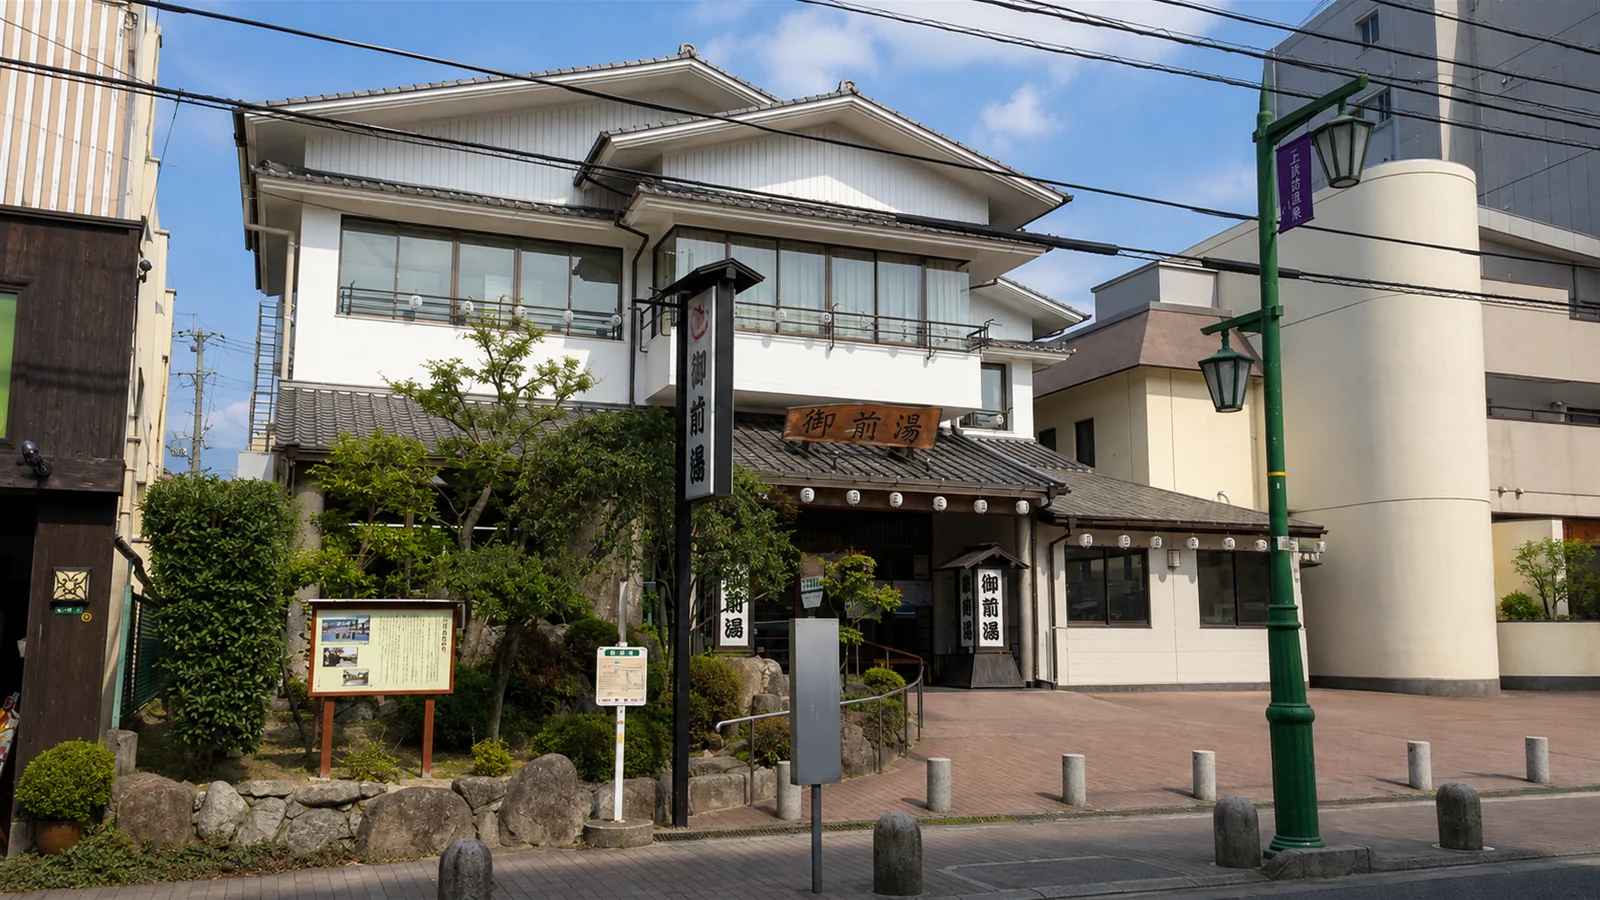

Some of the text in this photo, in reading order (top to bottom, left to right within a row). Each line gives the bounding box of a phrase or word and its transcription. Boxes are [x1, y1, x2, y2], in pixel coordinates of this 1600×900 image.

[1290, 148, 1302, 221] 上諏訪温泉
[690, 350, 706, 485] 御前湯
[802, 408, 922, 444] 御前湯
[724, 567, 745, 639] 前湯
[981, 573, 1000, 641] 御前湯
